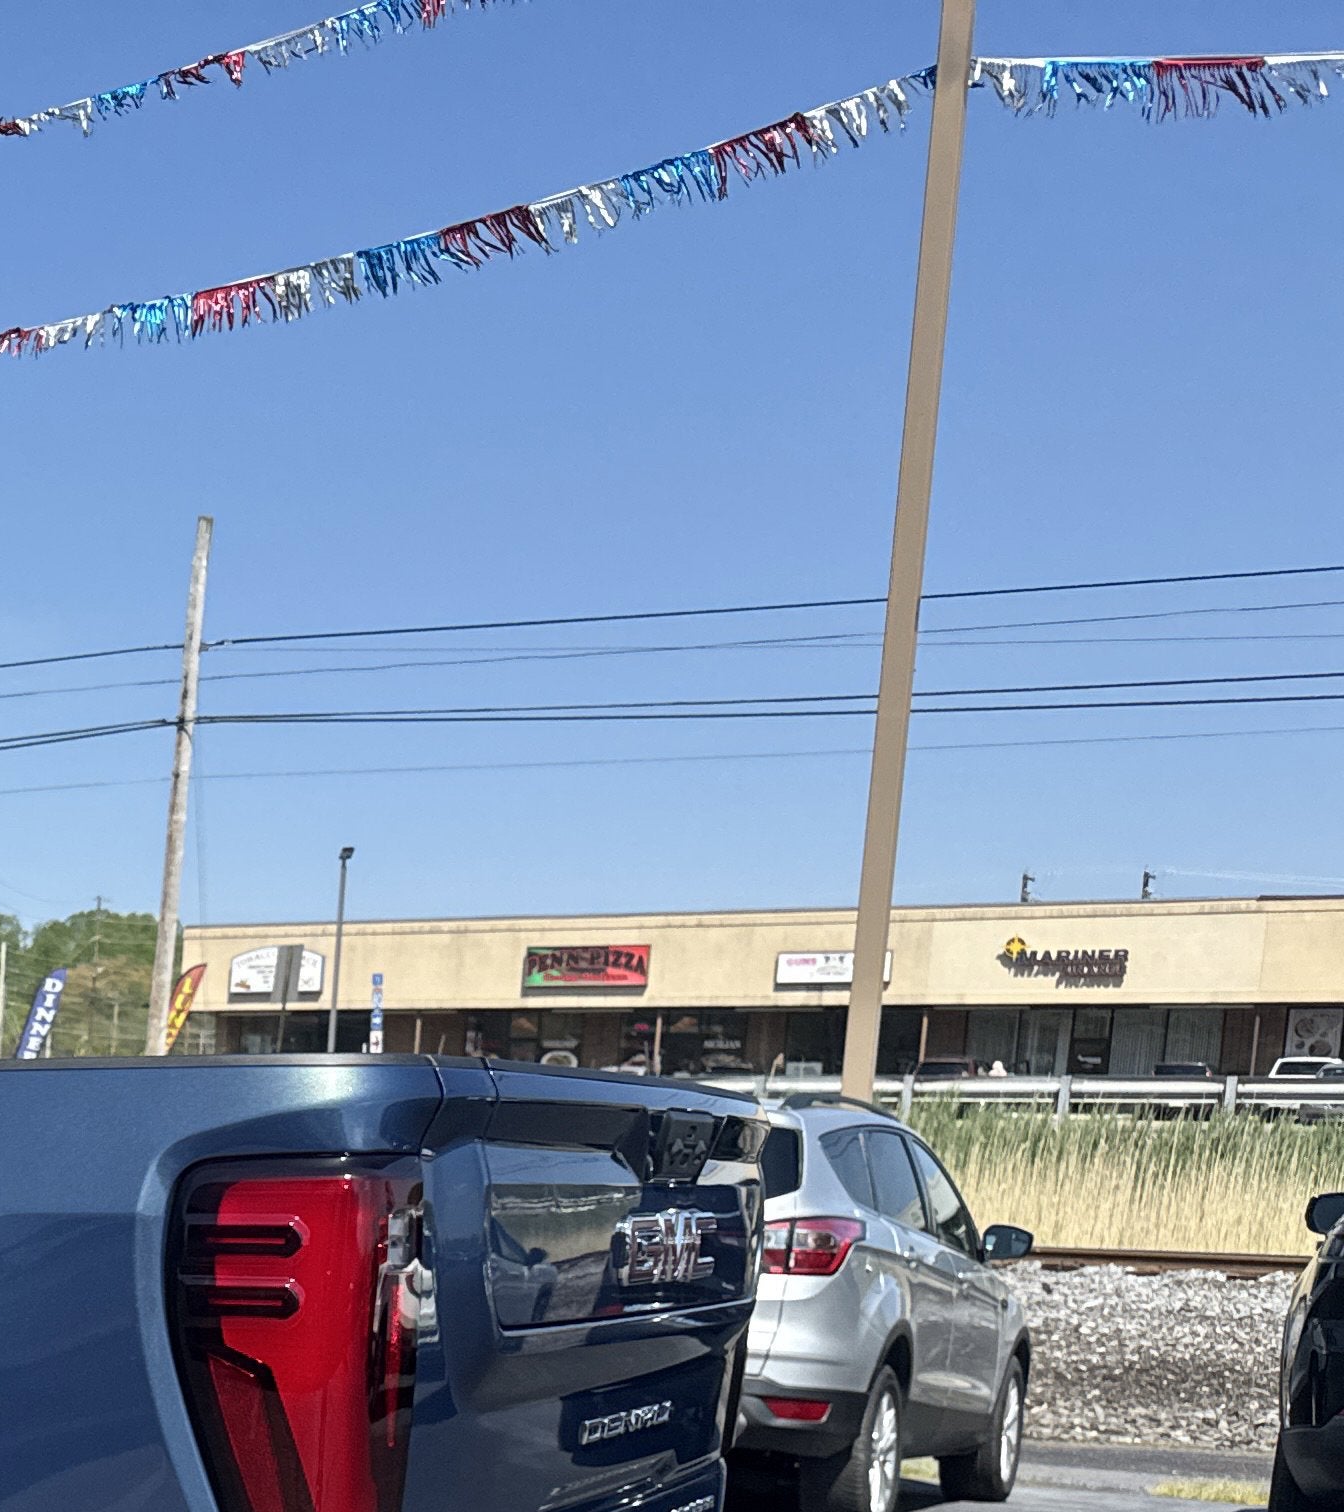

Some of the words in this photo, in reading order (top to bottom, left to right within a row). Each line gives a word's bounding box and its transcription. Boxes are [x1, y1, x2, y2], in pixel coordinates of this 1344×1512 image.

[590, 948, 646, 976] PIZZA
[1013, 948, 1129, 966] MARINER
[578, 1400, 672, 1446] DENALI
